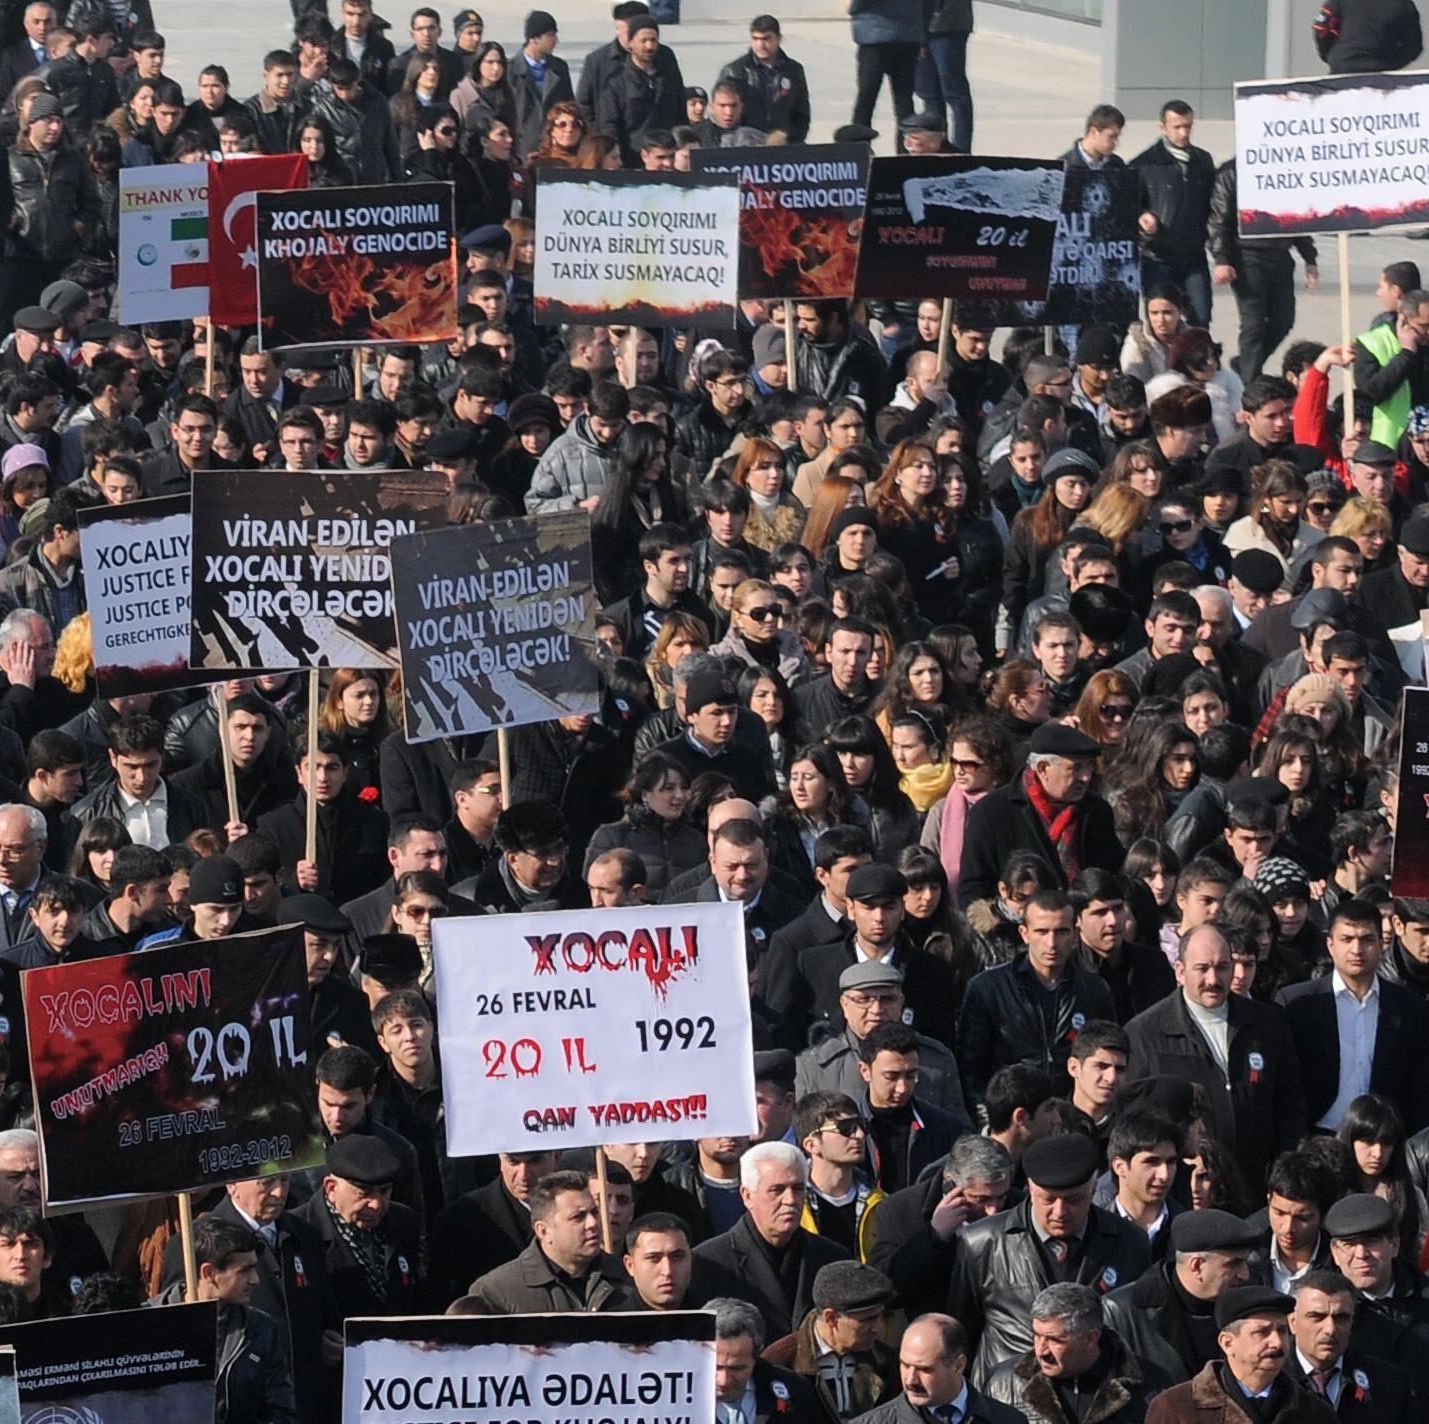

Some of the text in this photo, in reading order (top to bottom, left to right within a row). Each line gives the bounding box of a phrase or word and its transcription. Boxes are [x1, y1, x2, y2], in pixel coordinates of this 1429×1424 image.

[1263, 112, 1420, 137] XOCALI SOYQIRIMI
[1246, 144, 1306, 164] DÜNYA
[125, 188, 182, 206] THANK
[780, 188, 866, 208] GENOCIDE
[271, 203, 439, 232] XOCALI SOYQIRIMI
[562, 209, 717, 231] XOCALI SOYQIRIMI
[264, 230, 448, 259] KHOJALY GENOCIDE
[544, 232, 601, 253] DÜNYA
[976, 226, 1006, 246] 20
[223, 513, 308, 548] VİRAN
[101, 568, 175, 598] JUSTICE
[204, 555, 301, 583] XOCALI
[105, 599, 171, 624] JUSTICE
[408, 610, 486, 649] XOCALI
[524, 925, 701, 979] XOCALI
[476, 988, 597, 1015] 26 FEVRAL
[187, 1022, 251, 1084] 20
[482, 1015, 717, 1079] 20 1992
[118, 1105, 226, 1148] 26 FEVRAL
[523, 1106, 577, 1132] QAN
[198, 1134, 293, 1174] 1992-2012
[363, 1372, 693, 1411] XOCALIYA ƏDALƏT!
